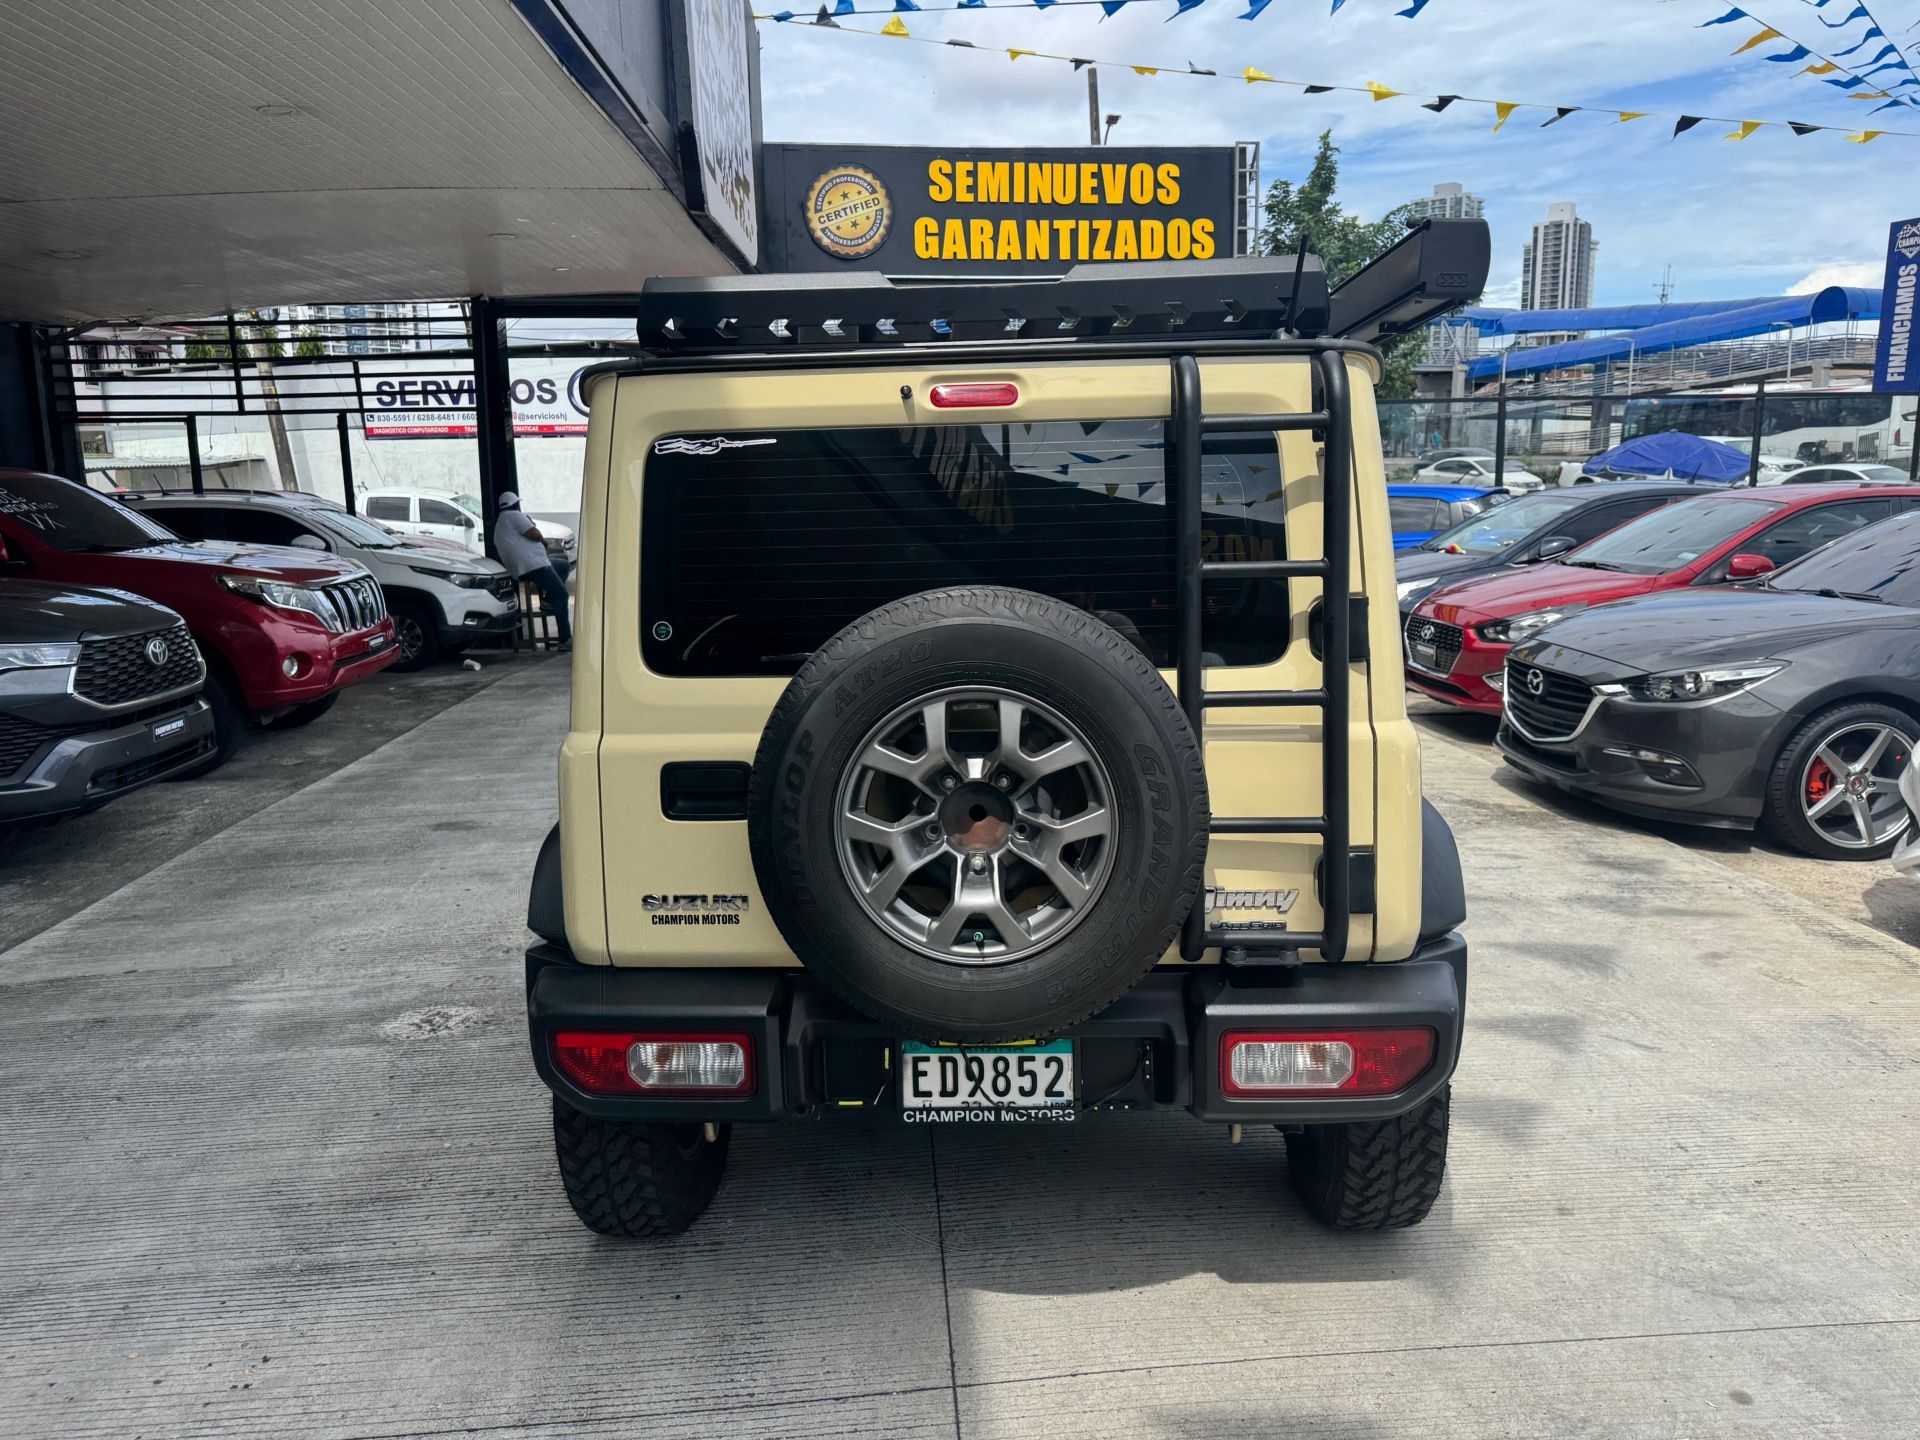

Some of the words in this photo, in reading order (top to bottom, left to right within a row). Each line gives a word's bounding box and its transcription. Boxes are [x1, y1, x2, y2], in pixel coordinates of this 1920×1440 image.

[928, 159, 1181, 205] SEMINUEVOS
[818, 197, 880, 225] CERTIFIED
[913, 216, 1215, 260] GARANTIZADOS
[1886, 263, 1918, 382] FINANCIAMOS
[376, 378, 558, 407] SERVIOS
[377, 414, 410, 422] 830-5591
[417, 413, 455, 421] 6288-6481
[518, 412, 568, 421] @servicioshj
[641, 894, 749, 911] SUZUKI
[652, 914, 700, 925] CHAMPION
[702, 914, 740, 925] MOTORS
[912, 1056, 1065, 1098] ED9852
[903, 1110, 995, 1123] CHAMPION
